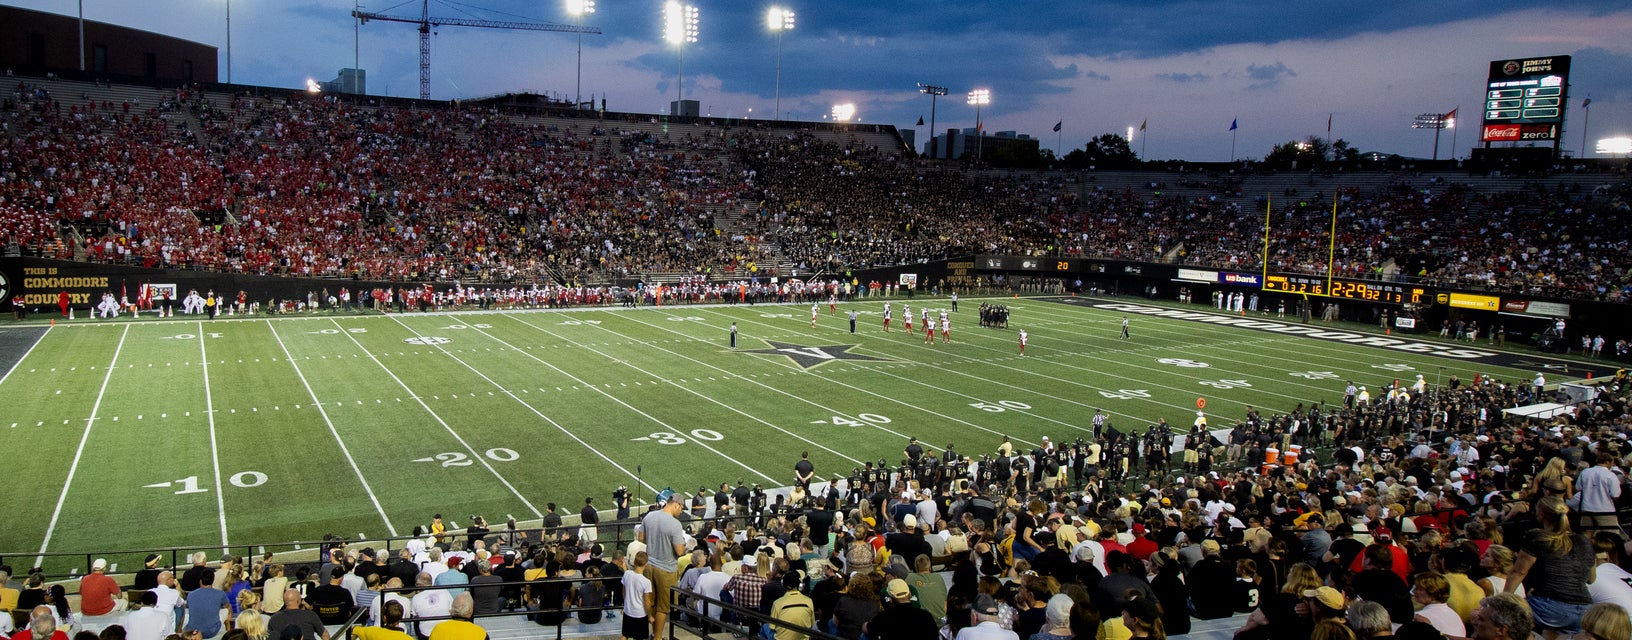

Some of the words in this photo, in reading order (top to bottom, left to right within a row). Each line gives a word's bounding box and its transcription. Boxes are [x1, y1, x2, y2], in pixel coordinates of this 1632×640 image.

[1523, 59, 1552, 67] JIMMY
[24, 267, 46, 275] THIS
[48, 267, 58, 275] IS
[1057, 262, 1069, 270] 20
[24, 277, 109, 288] COMMODORE
[1291, 284, 1296, 292] 3
[1300, 283, 1307, 293] 2
[1312, 285, 1322, 294] 16
[1331, 282, 1367, 298] 2:29
[24, 293, 91, 304] COUNRY
[1366, 289, 1380, 300] 32
[1395, 294, 1402, 303] 3
[1092, 302, 1501, 359] COMMODORES
[1248, 588, 1259, 607] 3
